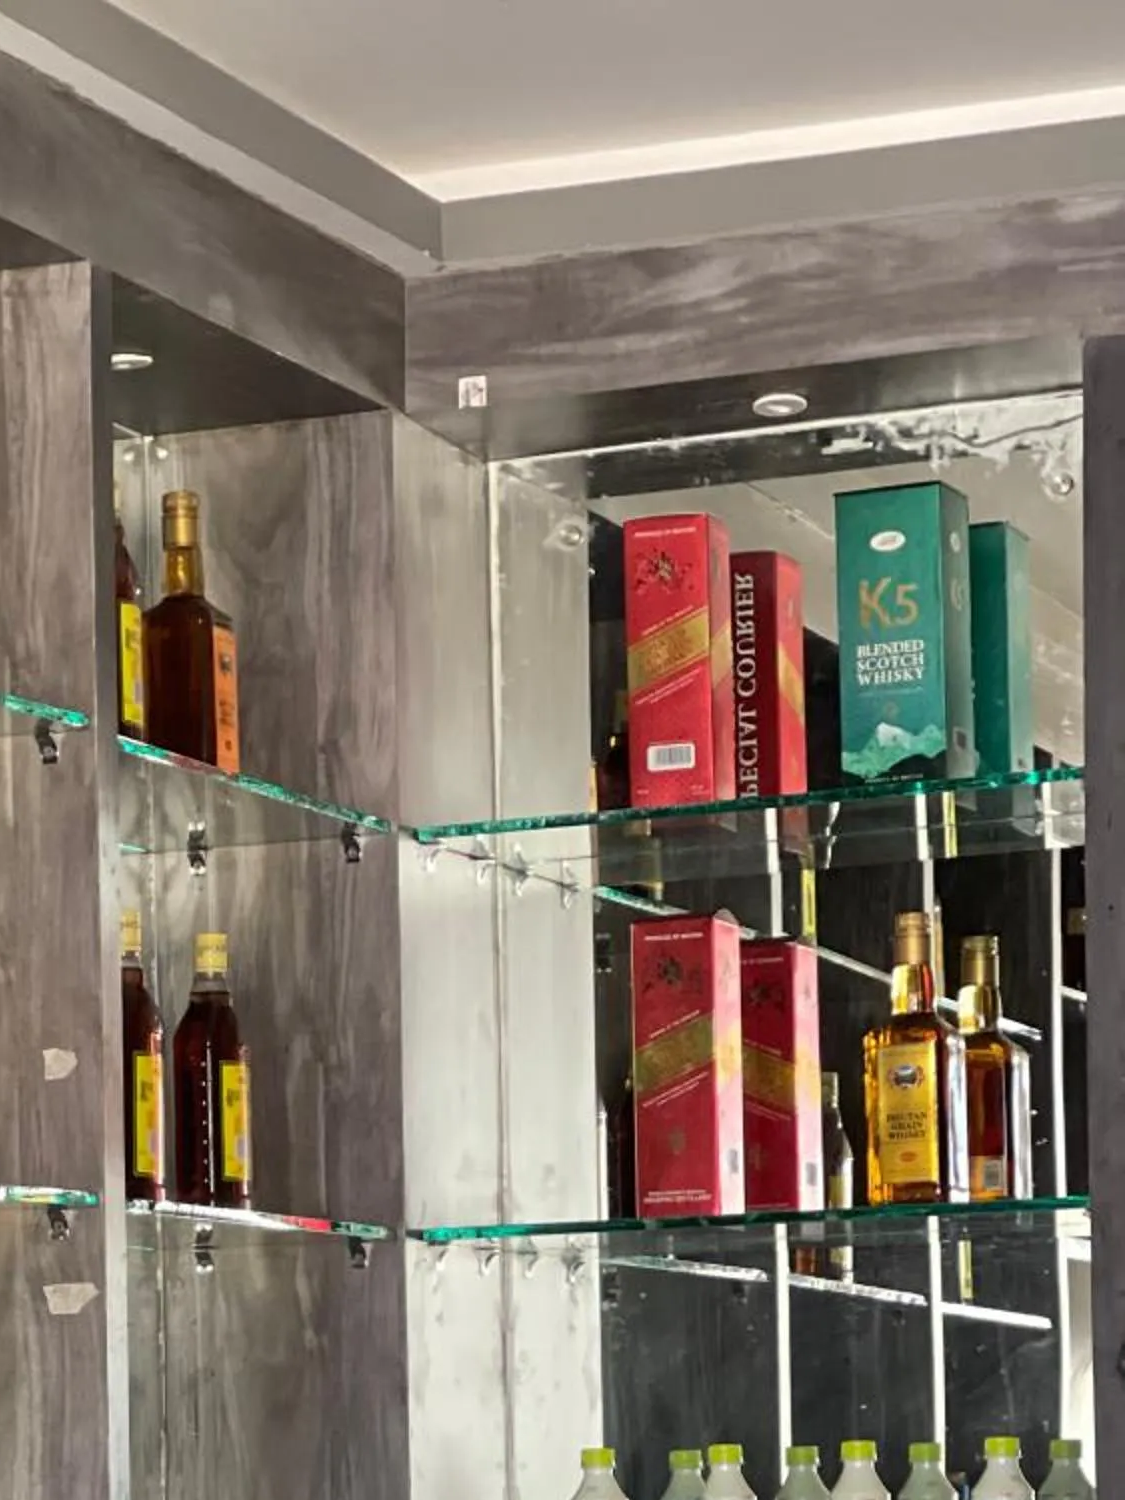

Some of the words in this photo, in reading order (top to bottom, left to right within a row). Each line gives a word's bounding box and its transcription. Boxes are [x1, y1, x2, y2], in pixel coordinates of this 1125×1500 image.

[858, 576, 920, 630] K5
[857, 639, 924, 658] BLENDED
[857, 652, 924, 671] SCOTCH
[857, 667, 924, 686] WHISKY
